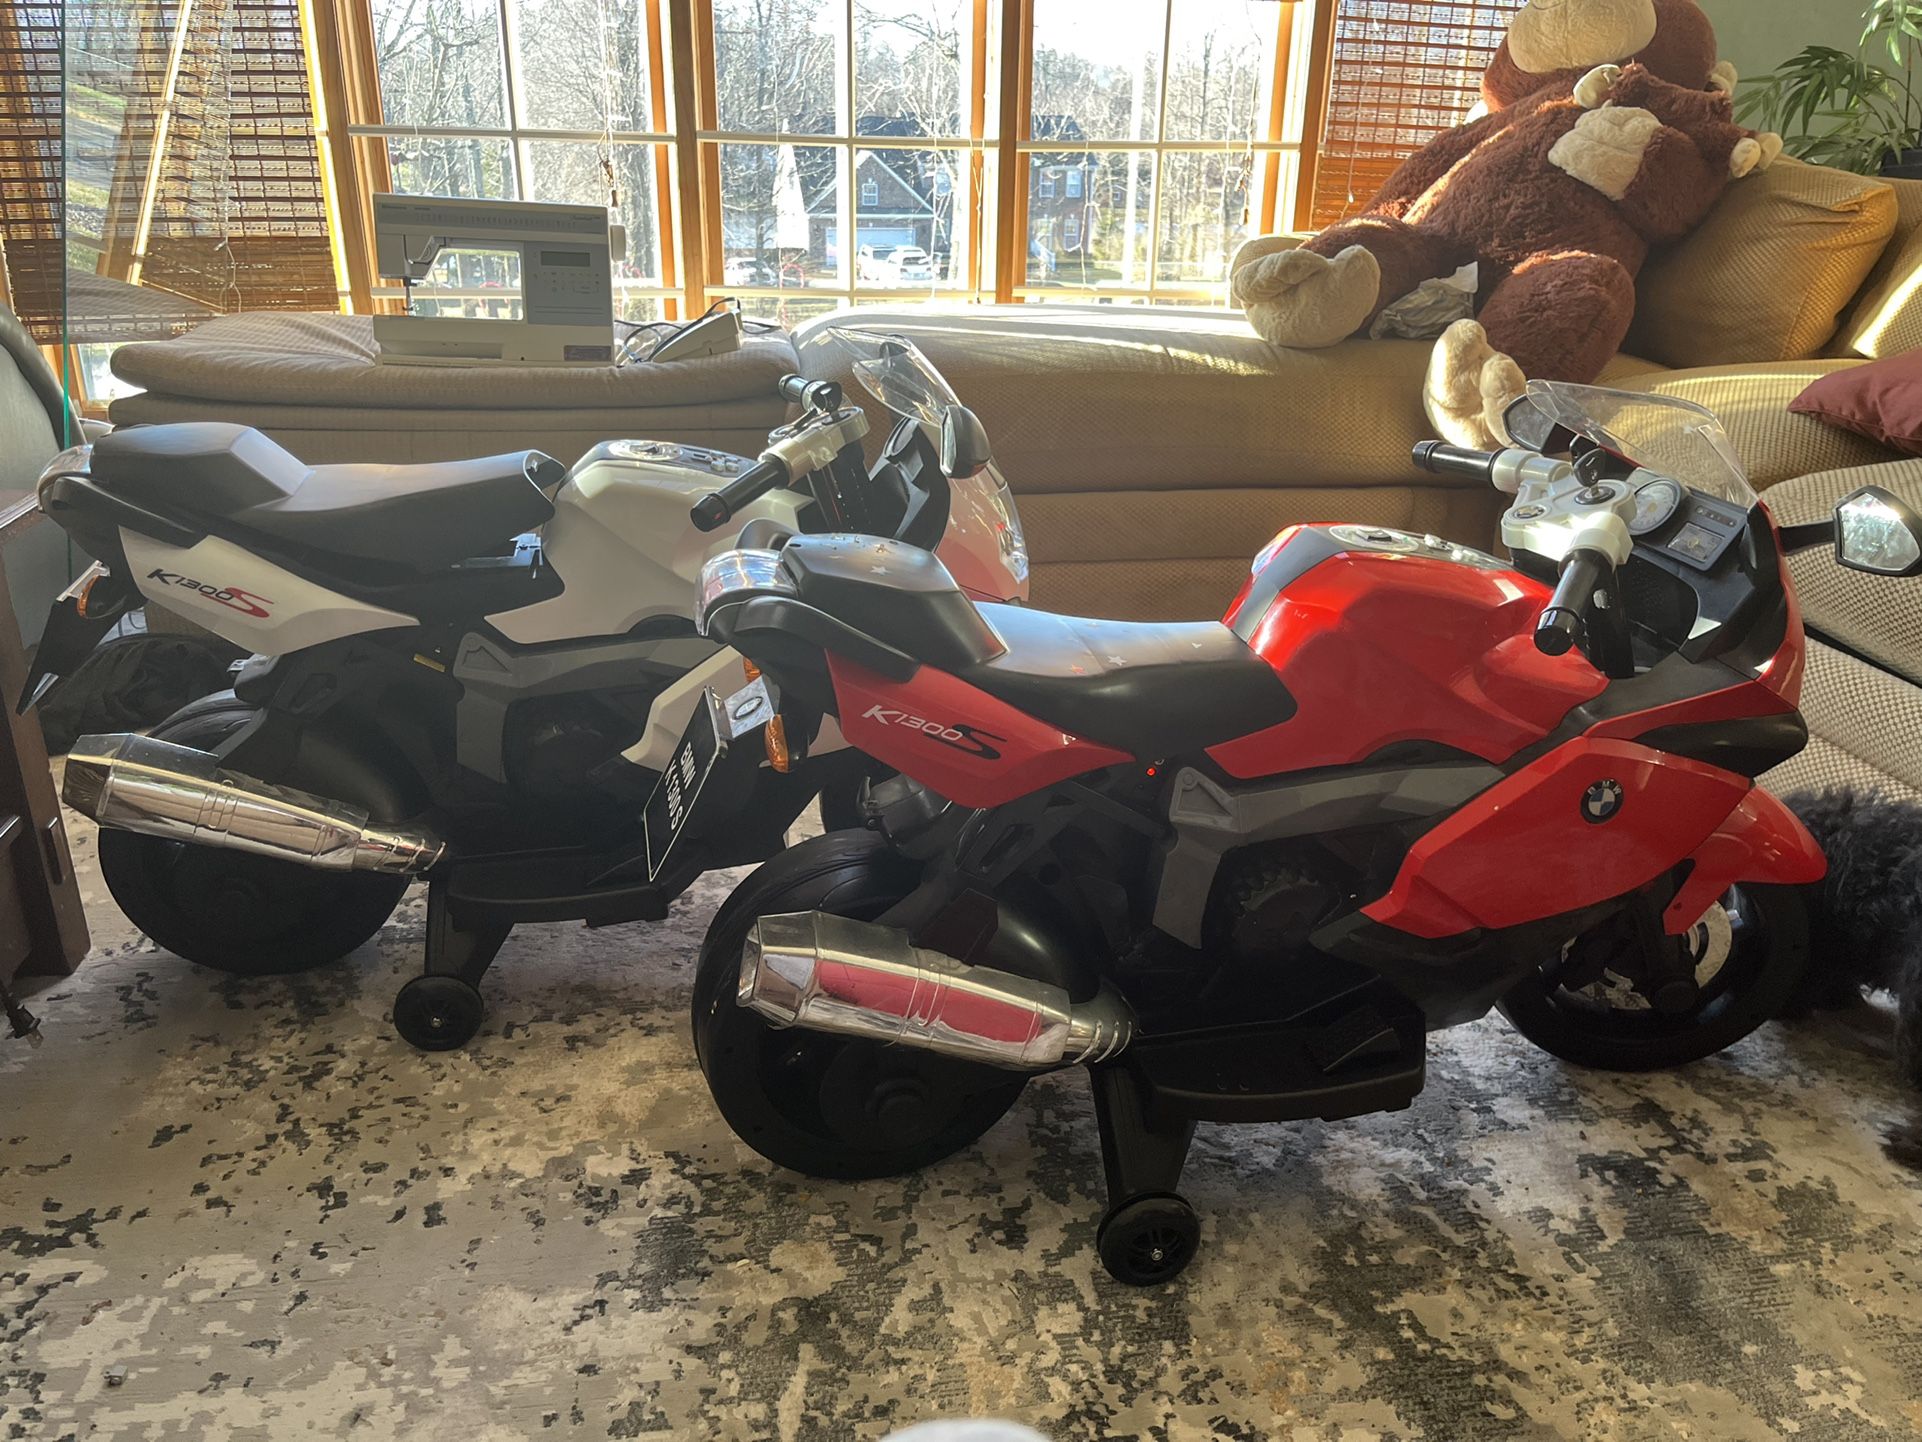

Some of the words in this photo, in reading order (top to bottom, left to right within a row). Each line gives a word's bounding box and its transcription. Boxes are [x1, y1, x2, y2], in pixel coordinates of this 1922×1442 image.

[147, 568, 274, 618] K1300S
[861, 704, 1008, 760] K1300S
[680, 741, 697, 790] BMW
